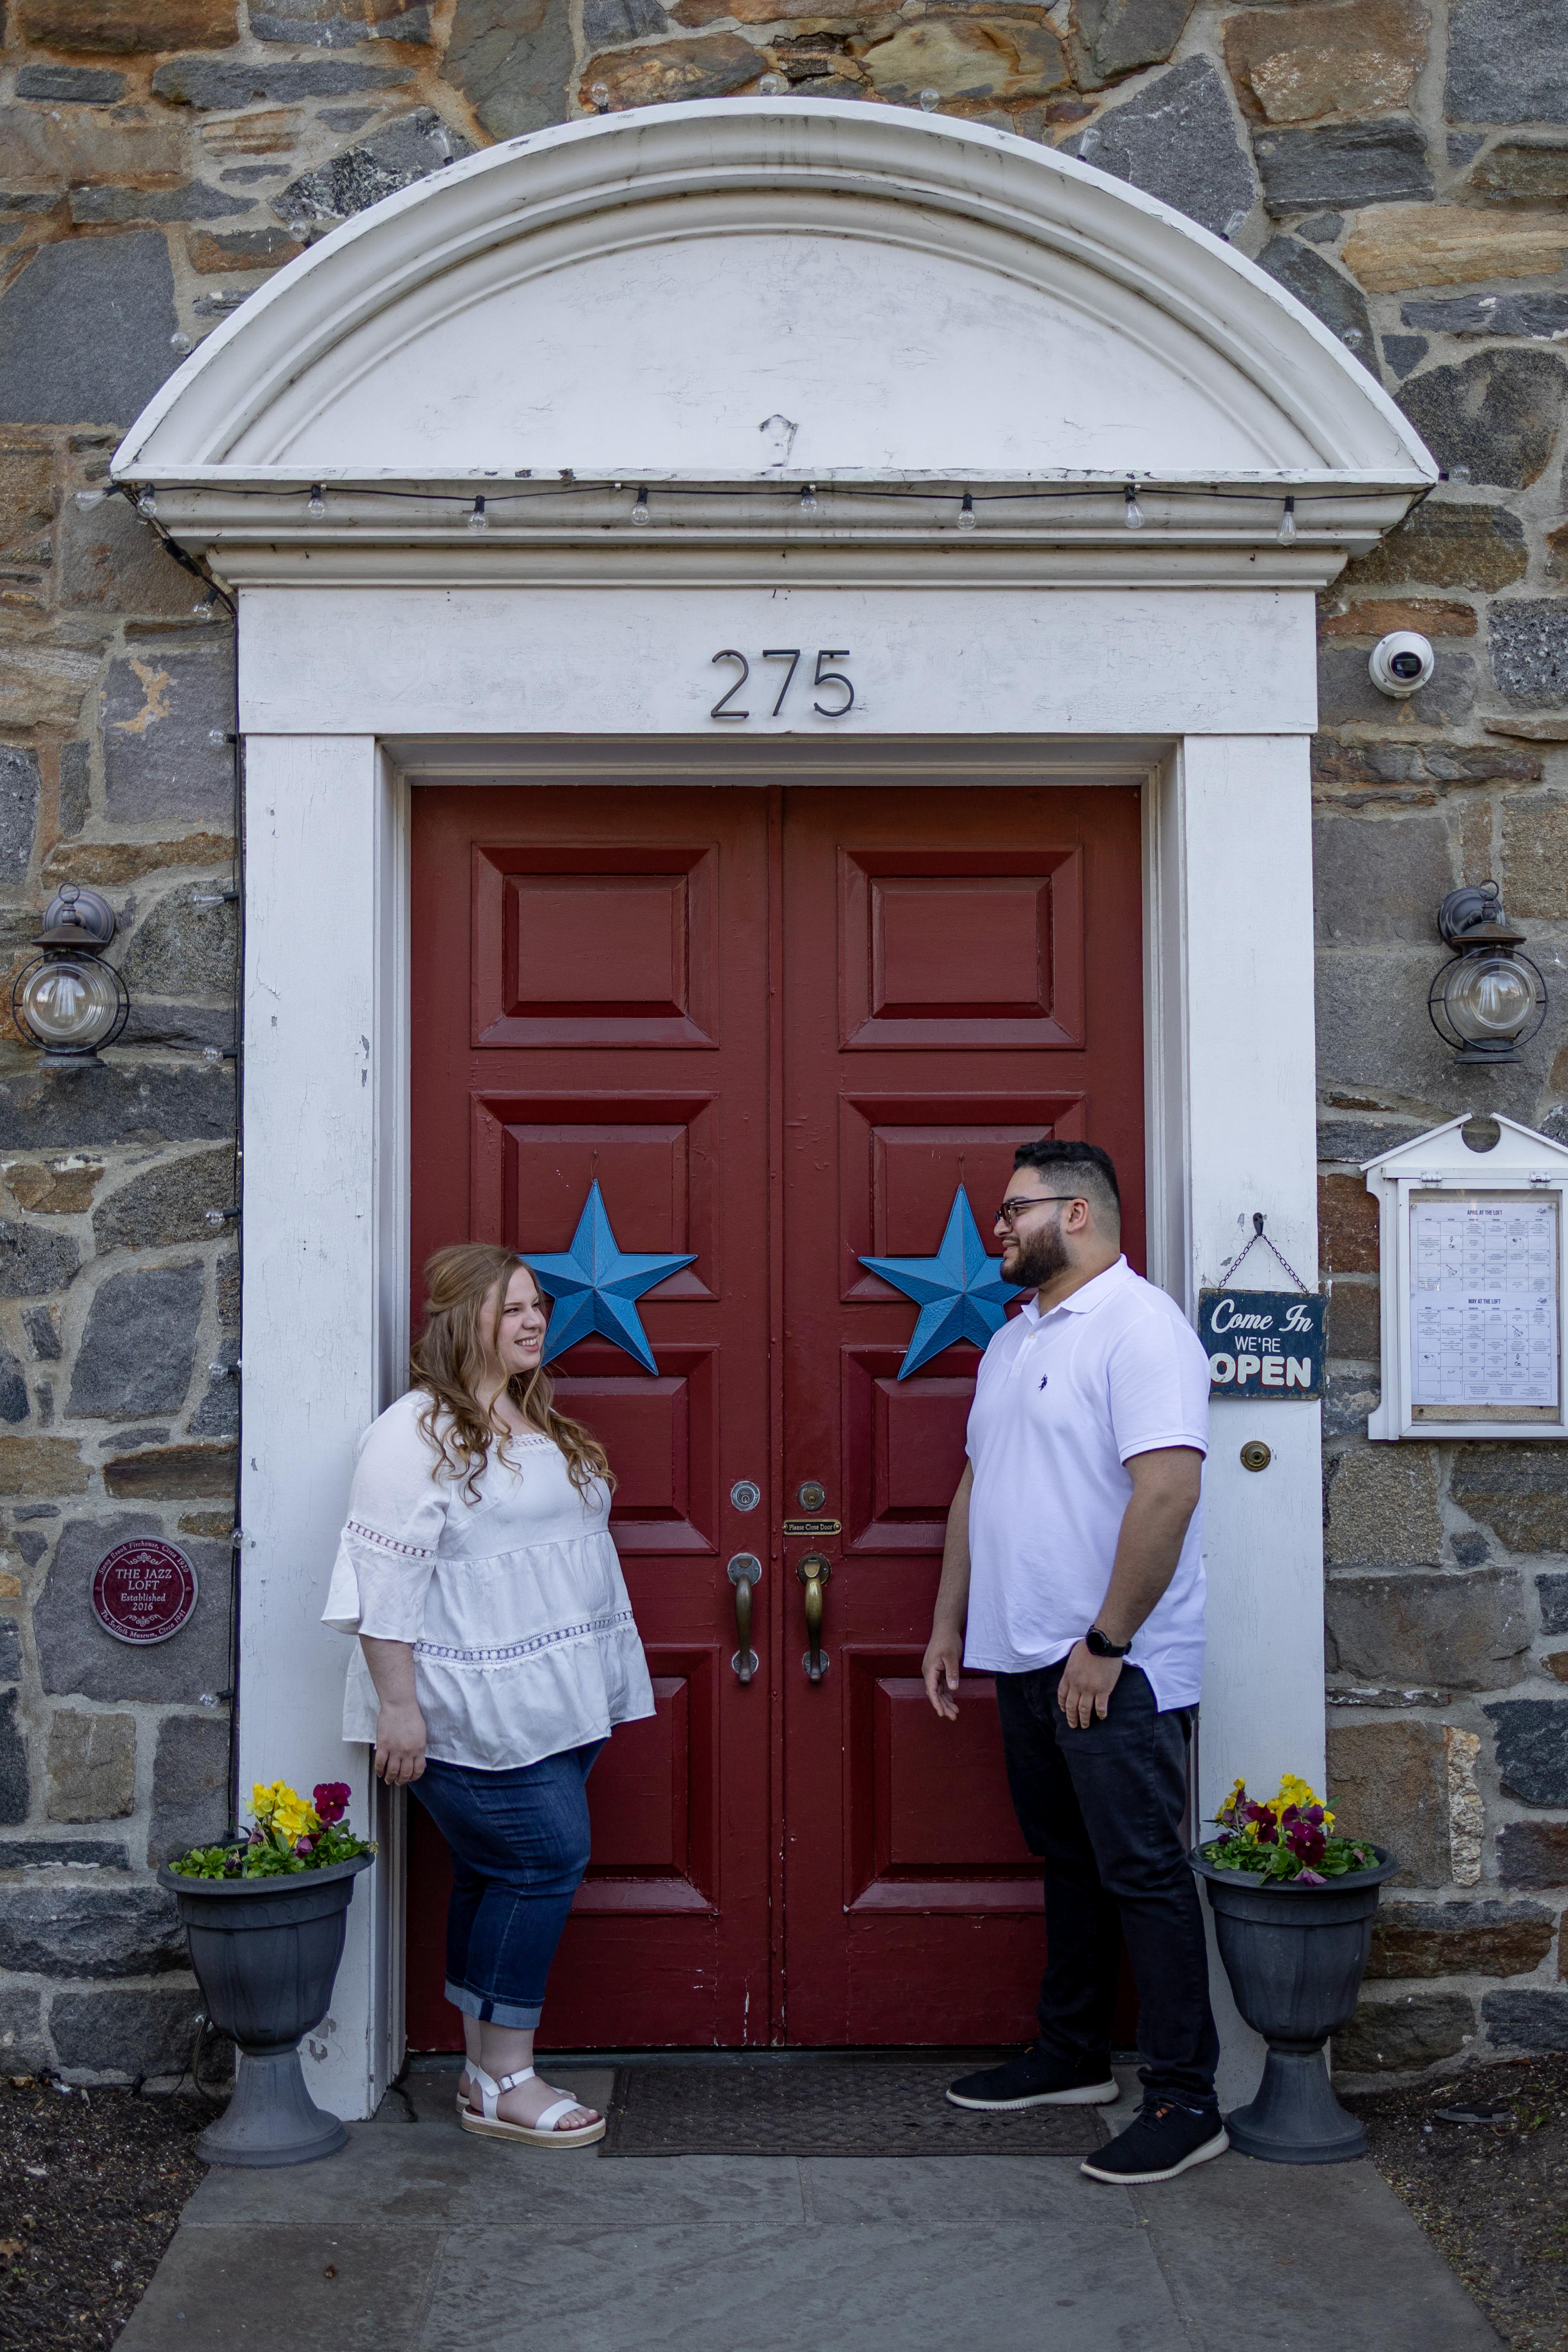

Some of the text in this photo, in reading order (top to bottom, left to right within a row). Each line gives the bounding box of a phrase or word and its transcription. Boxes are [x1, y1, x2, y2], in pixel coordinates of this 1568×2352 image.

[711, 649, 854, 717] 275
[1211, 1299, 1313, 1333] Come In
[1235, 1336, 1281, 1352] WE'RE
[1209, 1352, 1311, 1388] OPEN
[99, 1540, 189, 1575] Stony Brook Firehouse, Circa 1920
[115, 1569, 172, 1578] THE JAZZ
[128, 1580, 160, 1590] LOFT
[121, 1593, 166, 1602] Established
[132, 1602, 154, 1611] 2016
[101, 1609, 109, 1621] The
[109, 1620, 128, 1635] Suffolk
[159, 1622, 175, 1634] Circa
[174, 1609, 186, 1623] 1941
